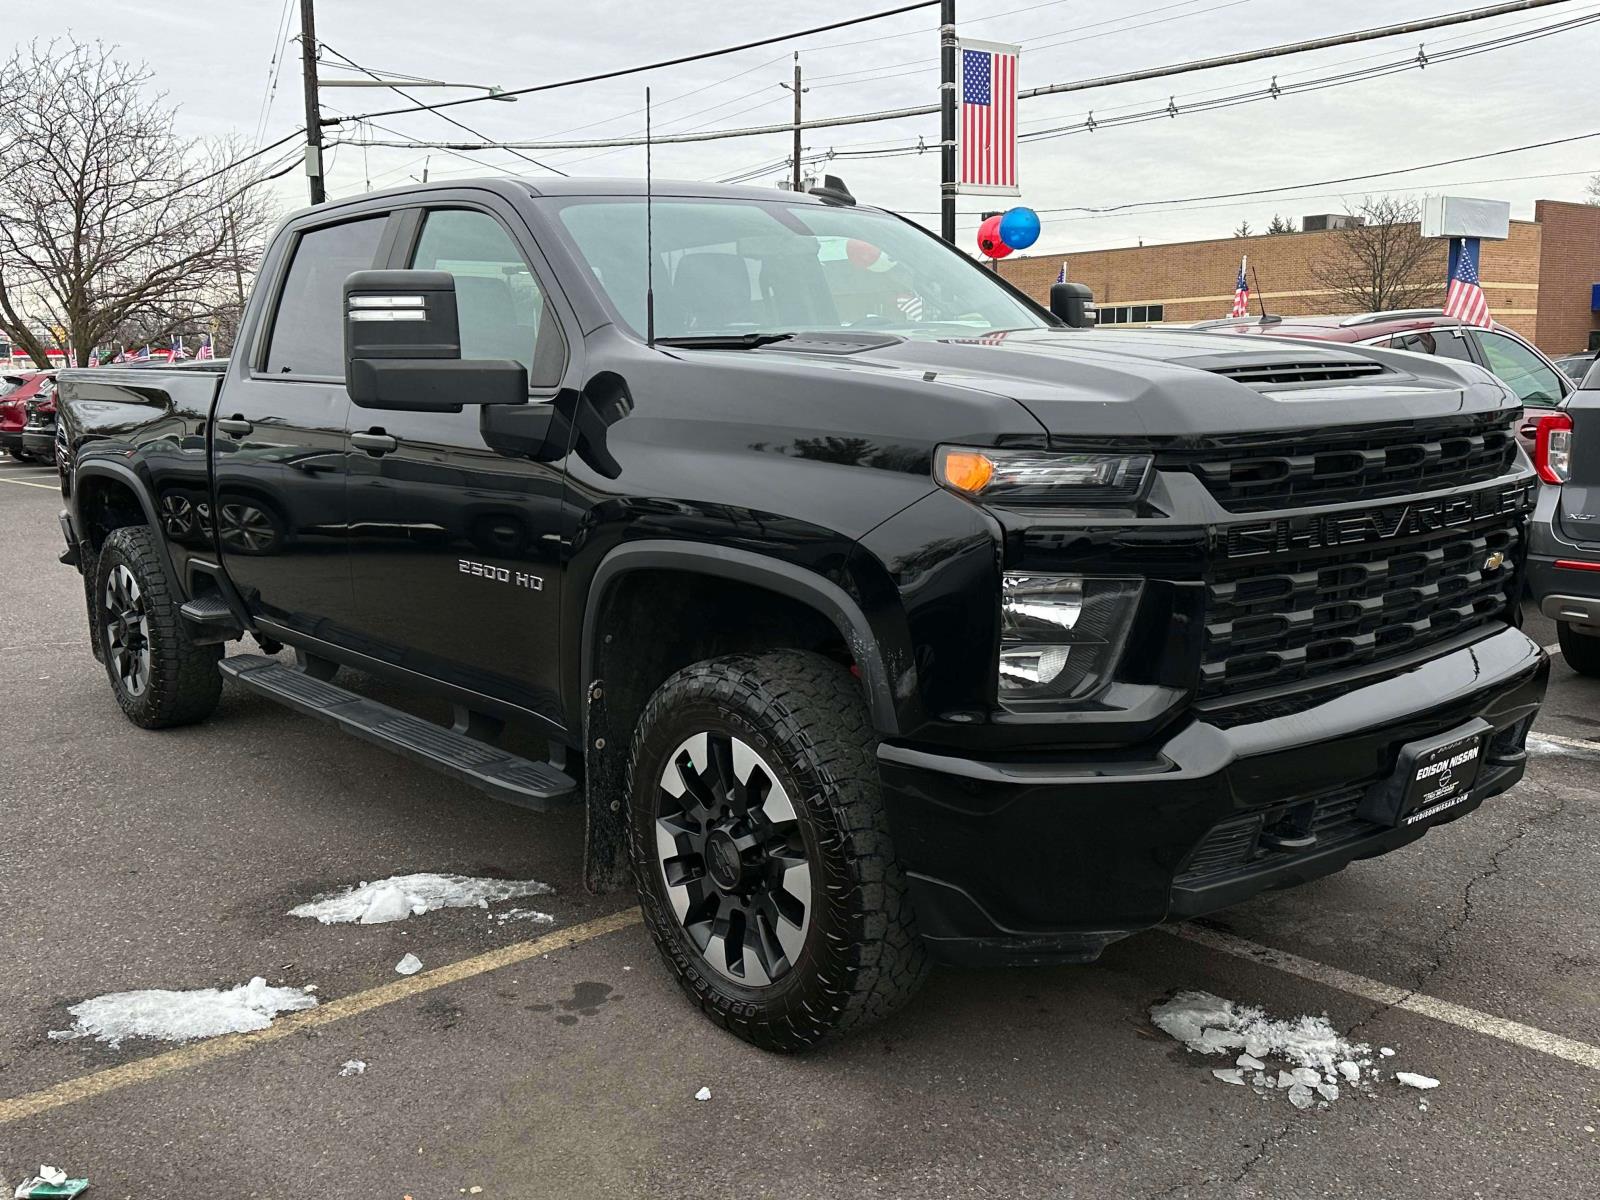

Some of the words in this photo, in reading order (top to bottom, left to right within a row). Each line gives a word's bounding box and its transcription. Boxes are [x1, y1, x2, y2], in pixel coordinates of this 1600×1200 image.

[1227, 485, 1534, 558] CHEVROLET
[459, 559, 509, 583] 2500
[516, 571, 543, 591] HD
[718, 706, 769, 748] TOYO
[1415, 760, 1449, 781] EDISON
[1449, 746, 1479, 769] NISSAN
[1407, 793, 1469, 825] MYEDISONNISSAN.COM
[707, 991, 758, 1018] OPEN
